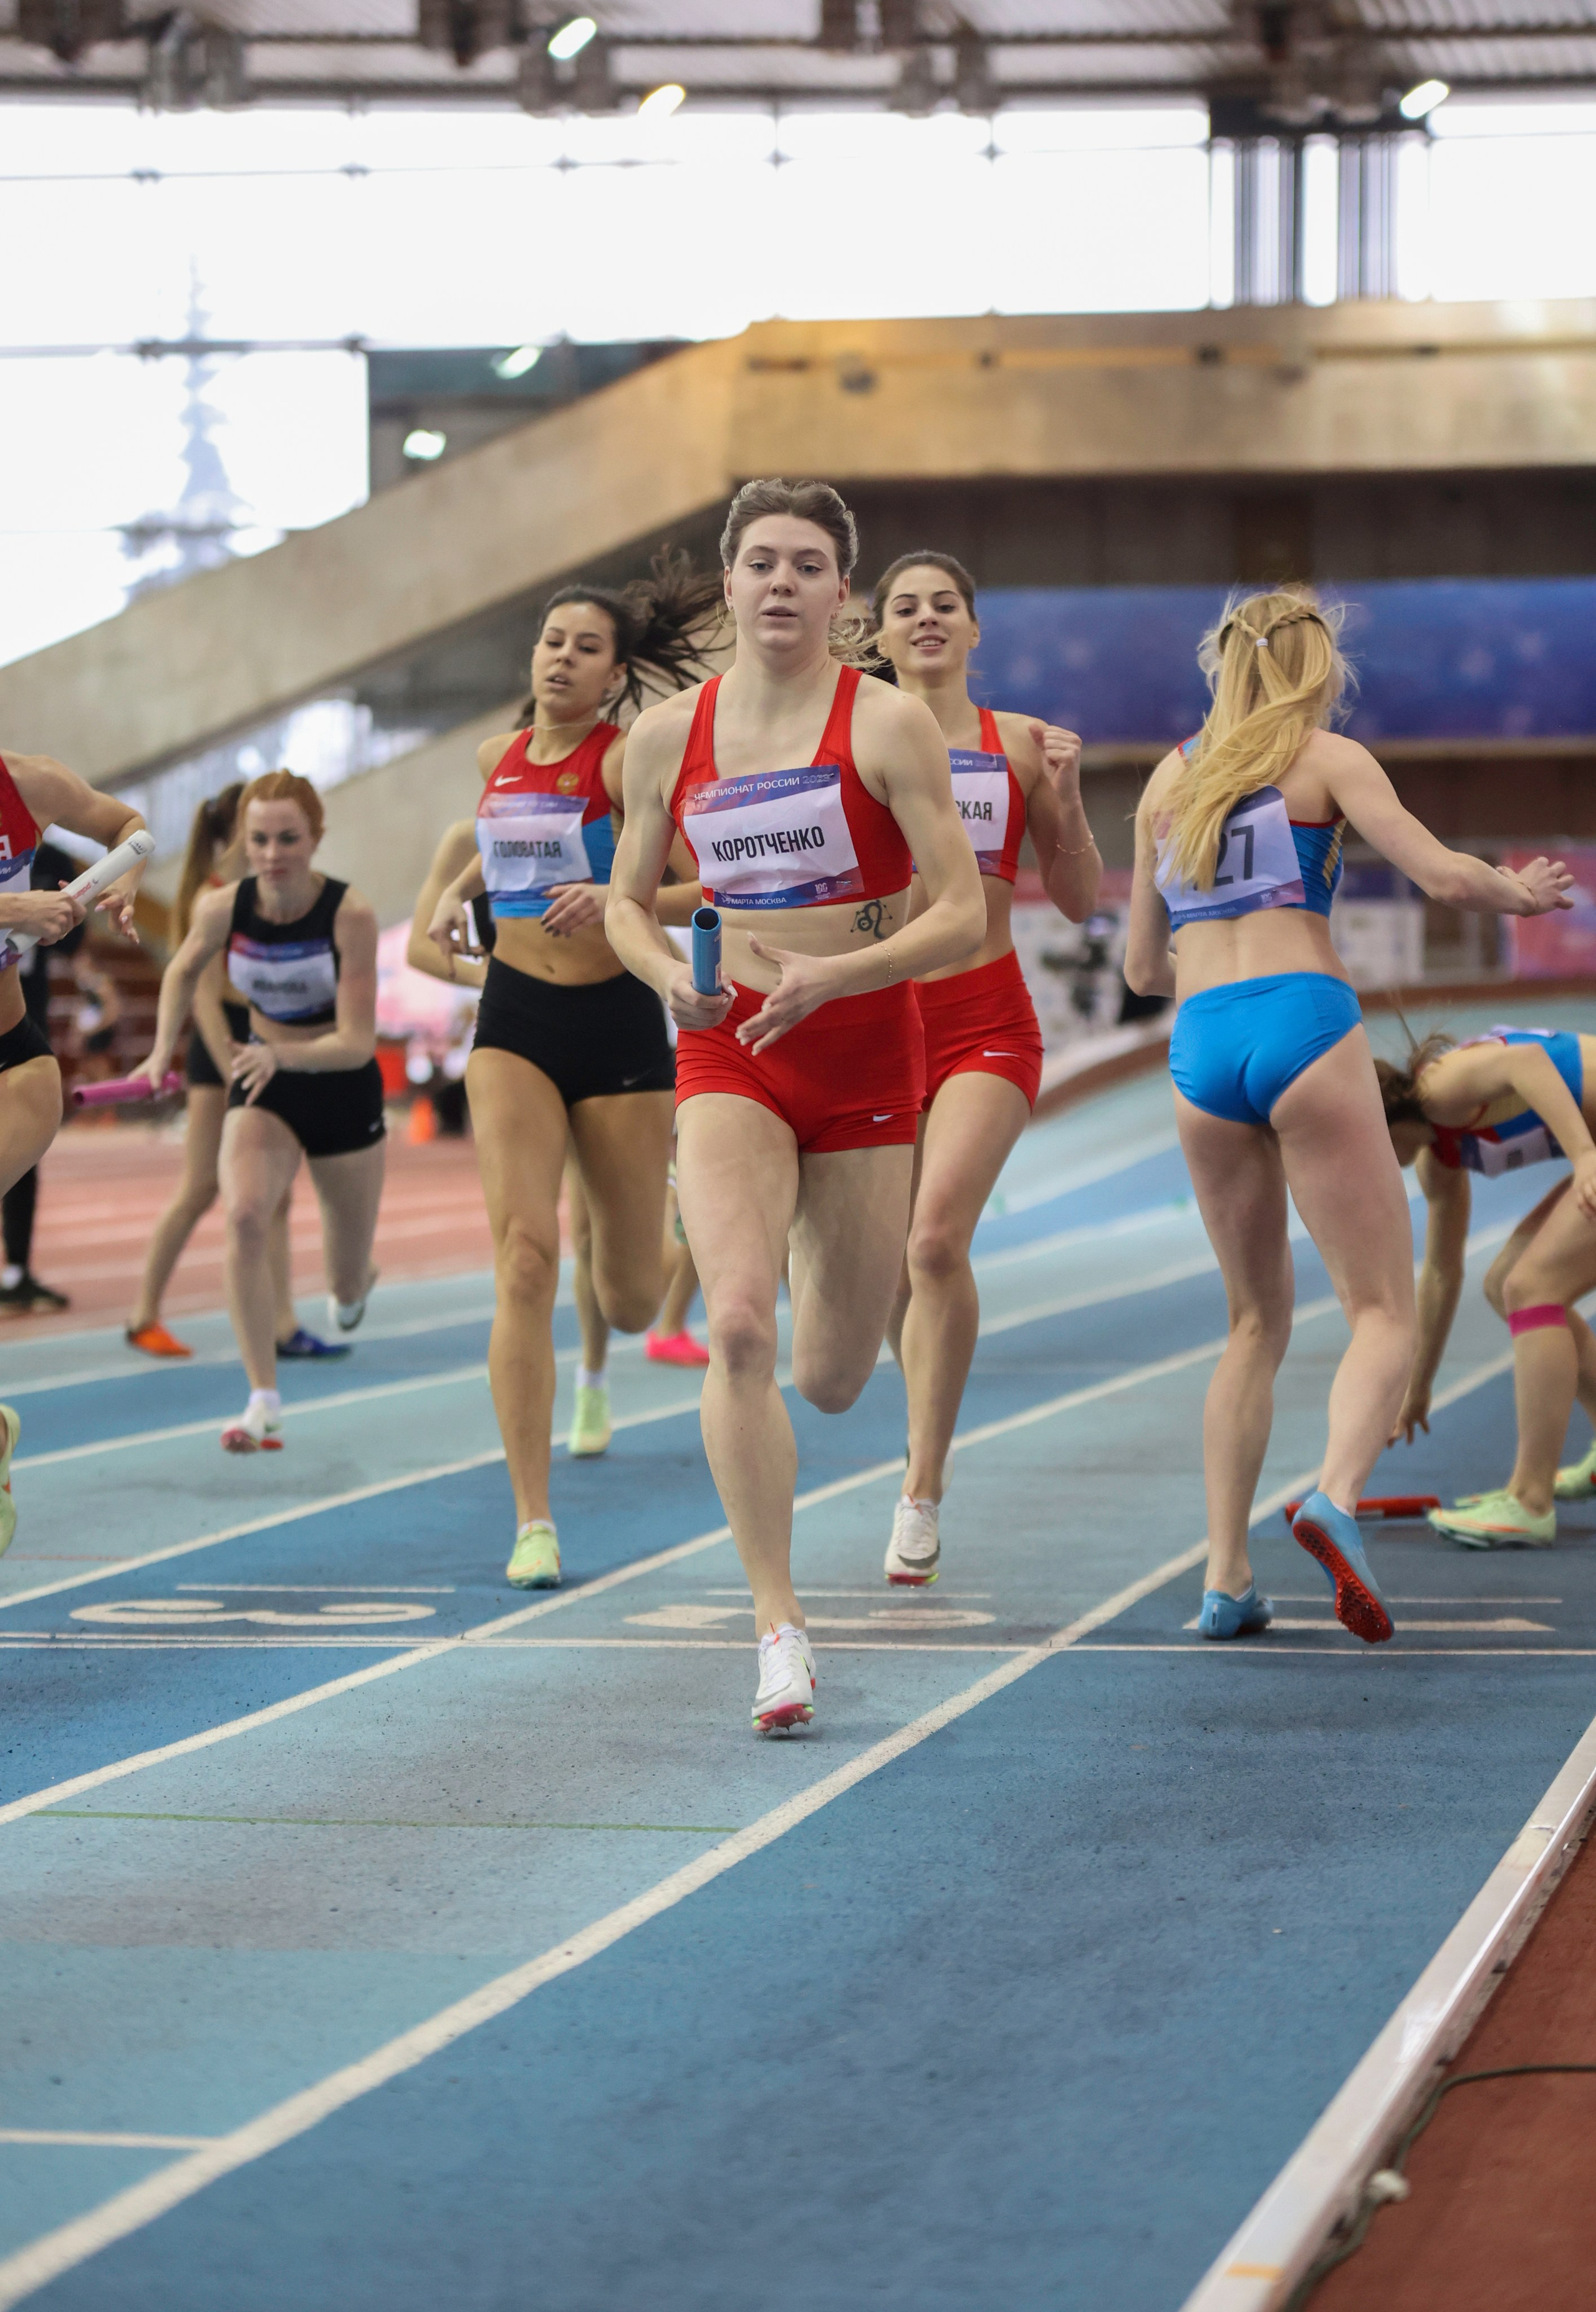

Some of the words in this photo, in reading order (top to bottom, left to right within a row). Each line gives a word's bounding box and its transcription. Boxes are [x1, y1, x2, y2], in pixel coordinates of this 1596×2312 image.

[694, 784, 754, 801] ЧЕМПИОНАТ
[757, 777, 800, 791] РОССИИ
[711, 826, 825, 862] КОРОТЧЕНКО
